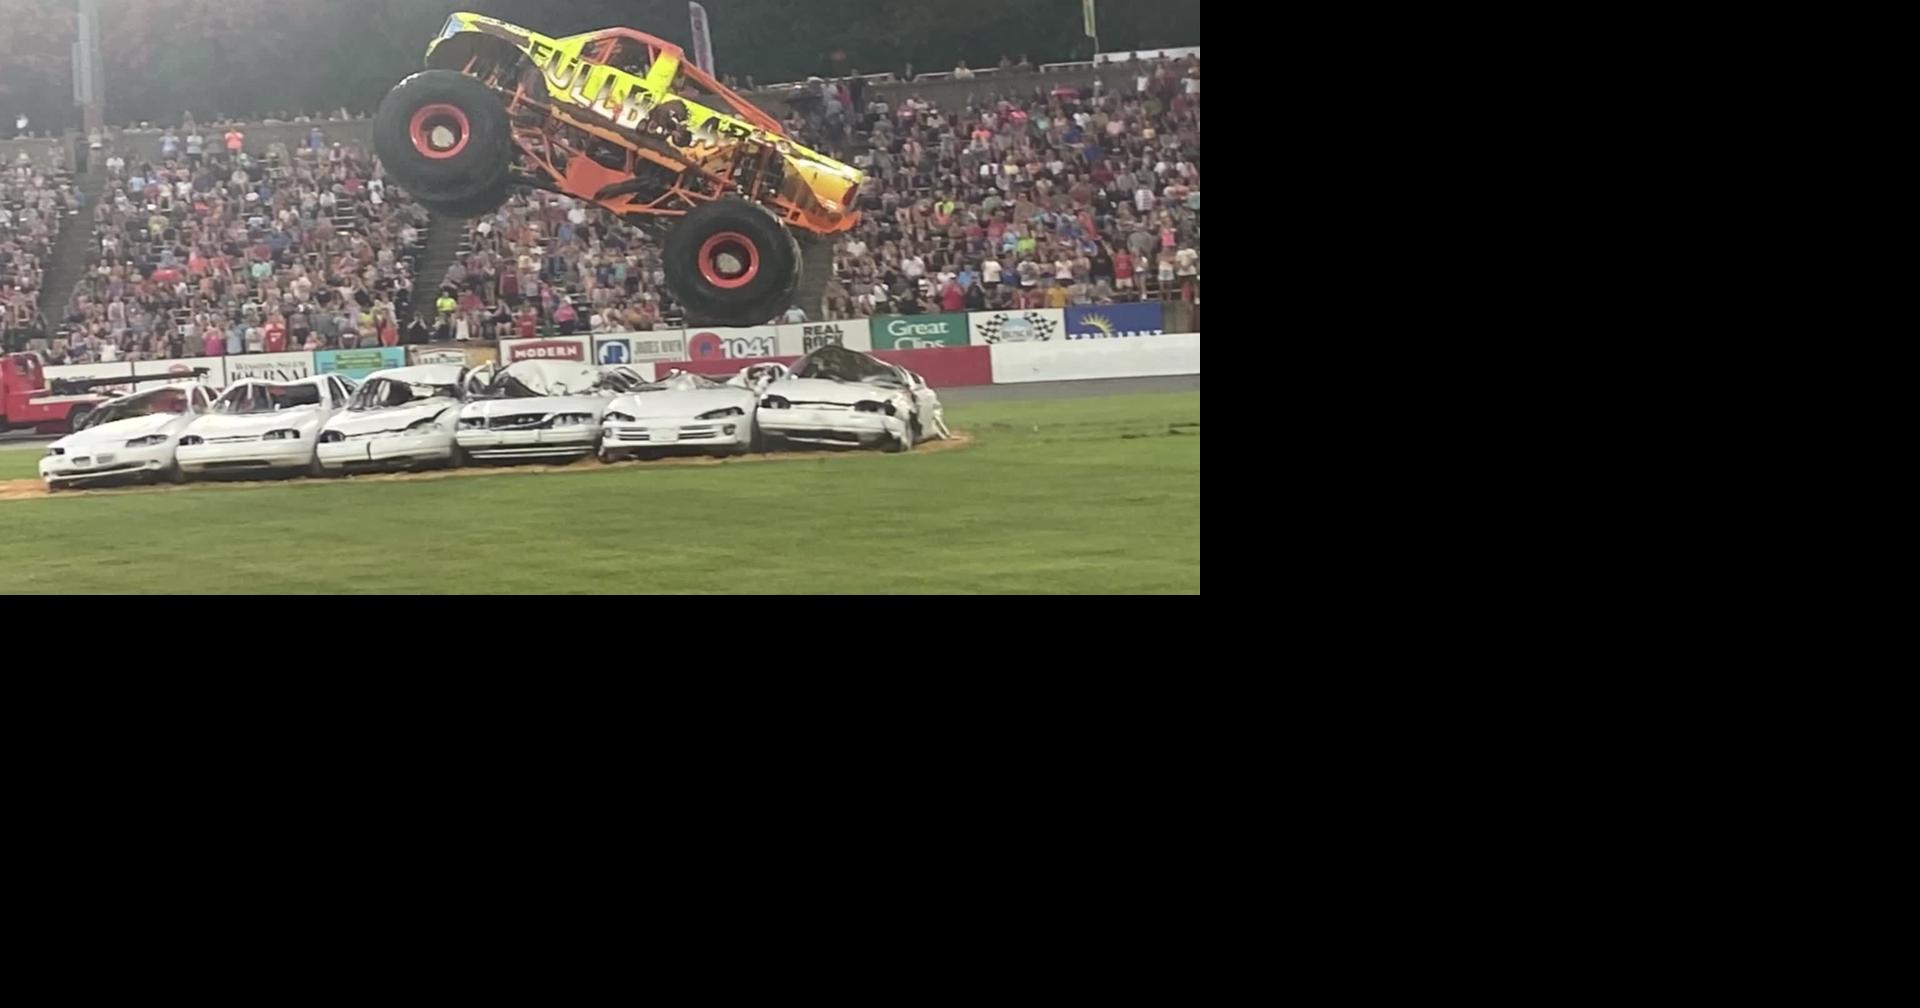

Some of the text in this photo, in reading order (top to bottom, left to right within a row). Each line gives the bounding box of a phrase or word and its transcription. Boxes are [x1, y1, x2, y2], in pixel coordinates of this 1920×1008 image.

[530, 40, 617, 121] FULL
[803, 323, 843, 335] REAL
[887, 319, 950, 336] Great
[514, 345, 578, 359] MODERN
[803, 333, 844, 354] ROCK
